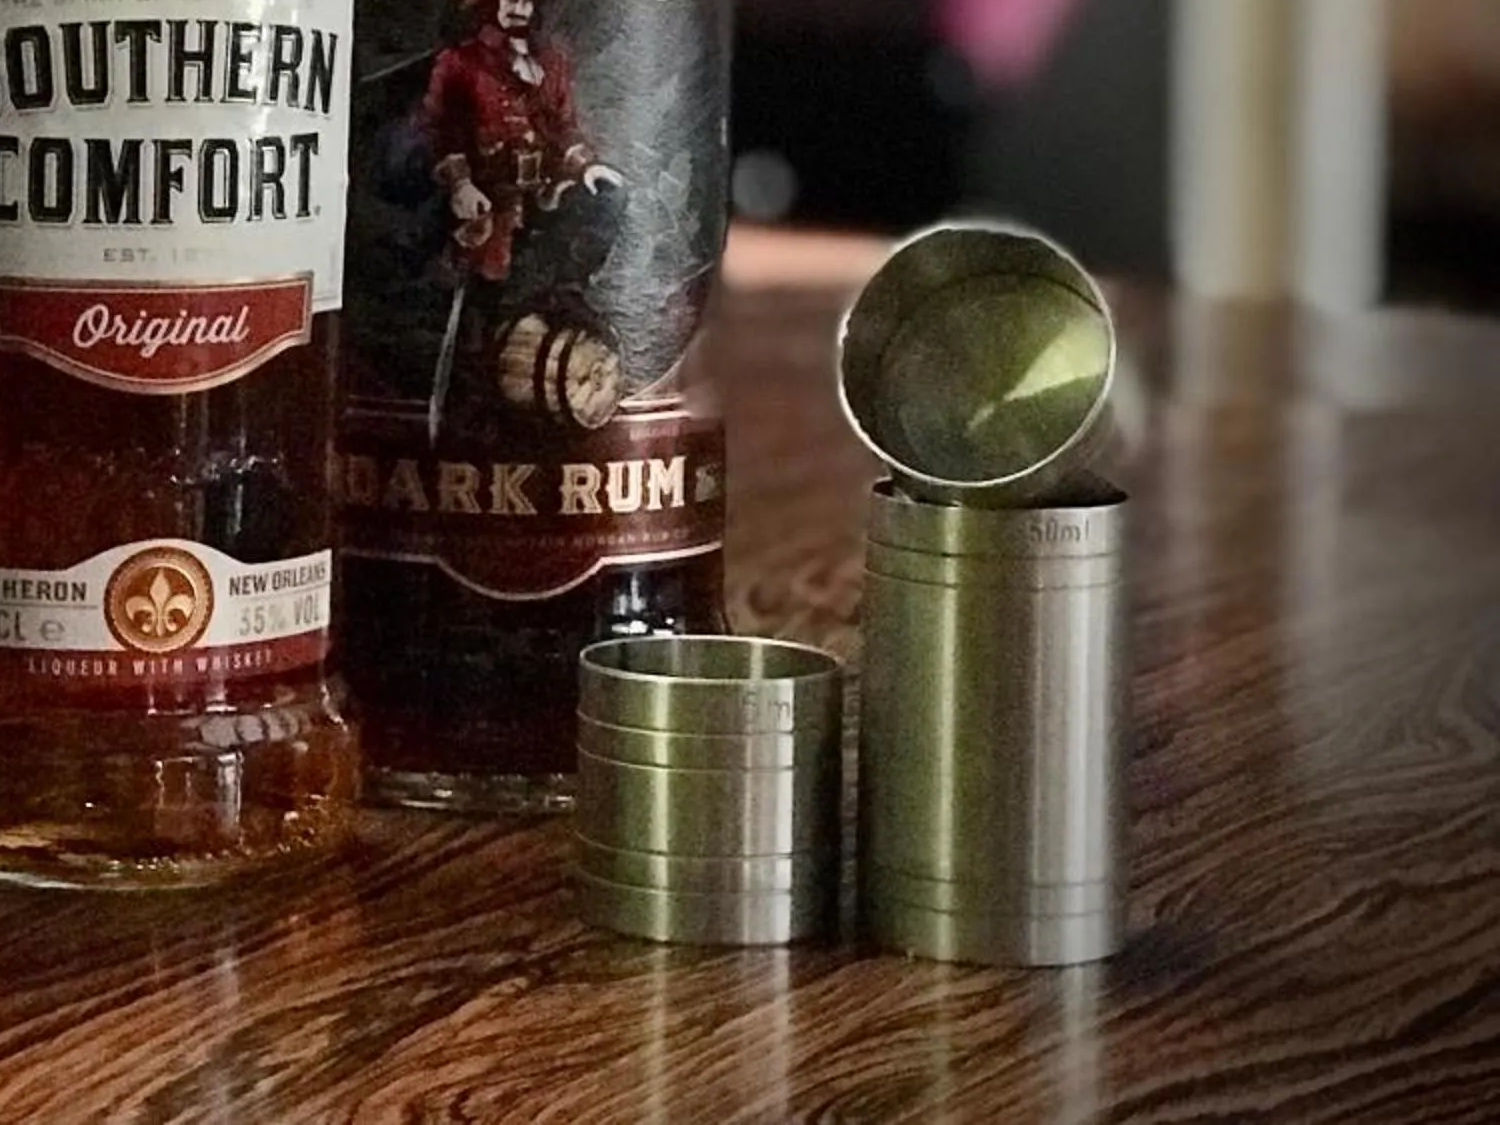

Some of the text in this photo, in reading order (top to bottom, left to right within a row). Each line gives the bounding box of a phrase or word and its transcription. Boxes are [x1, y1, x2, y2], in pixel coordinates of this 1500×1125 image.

[72, 302, 251, 359] Original
[338, 453, 687, 516] DARK RUM
[2, 579, 88, 602] HERON
[228, 562, 328, 597] NEW ORLEANS
[28, 656, 118, 677] LIQUEUR
[132, 657, 184, 676] WITH
